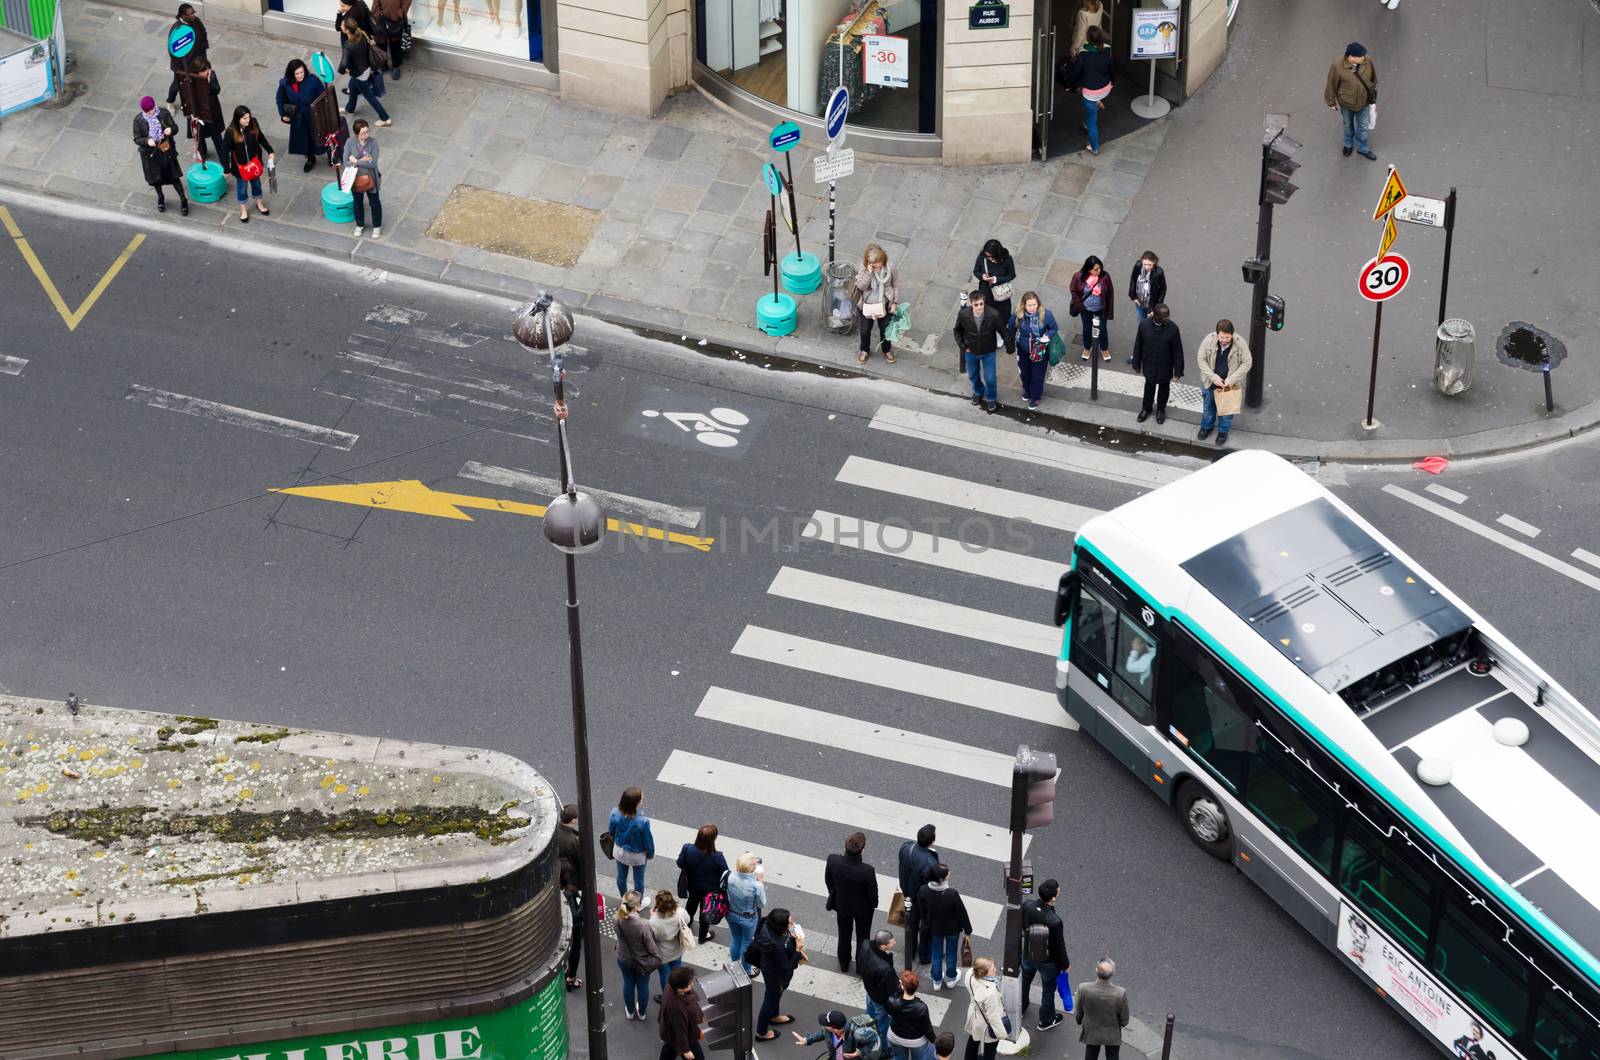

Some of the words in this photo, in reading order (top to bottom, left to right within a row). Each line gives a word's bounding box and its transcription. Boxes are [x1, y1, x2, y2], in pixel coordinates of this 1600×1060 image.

[1368, 266, 1400, 289] 30
[1382, 944, 1404, 974] ÉRIC
[1408, 970, 1452, 1017] ANTOINE
